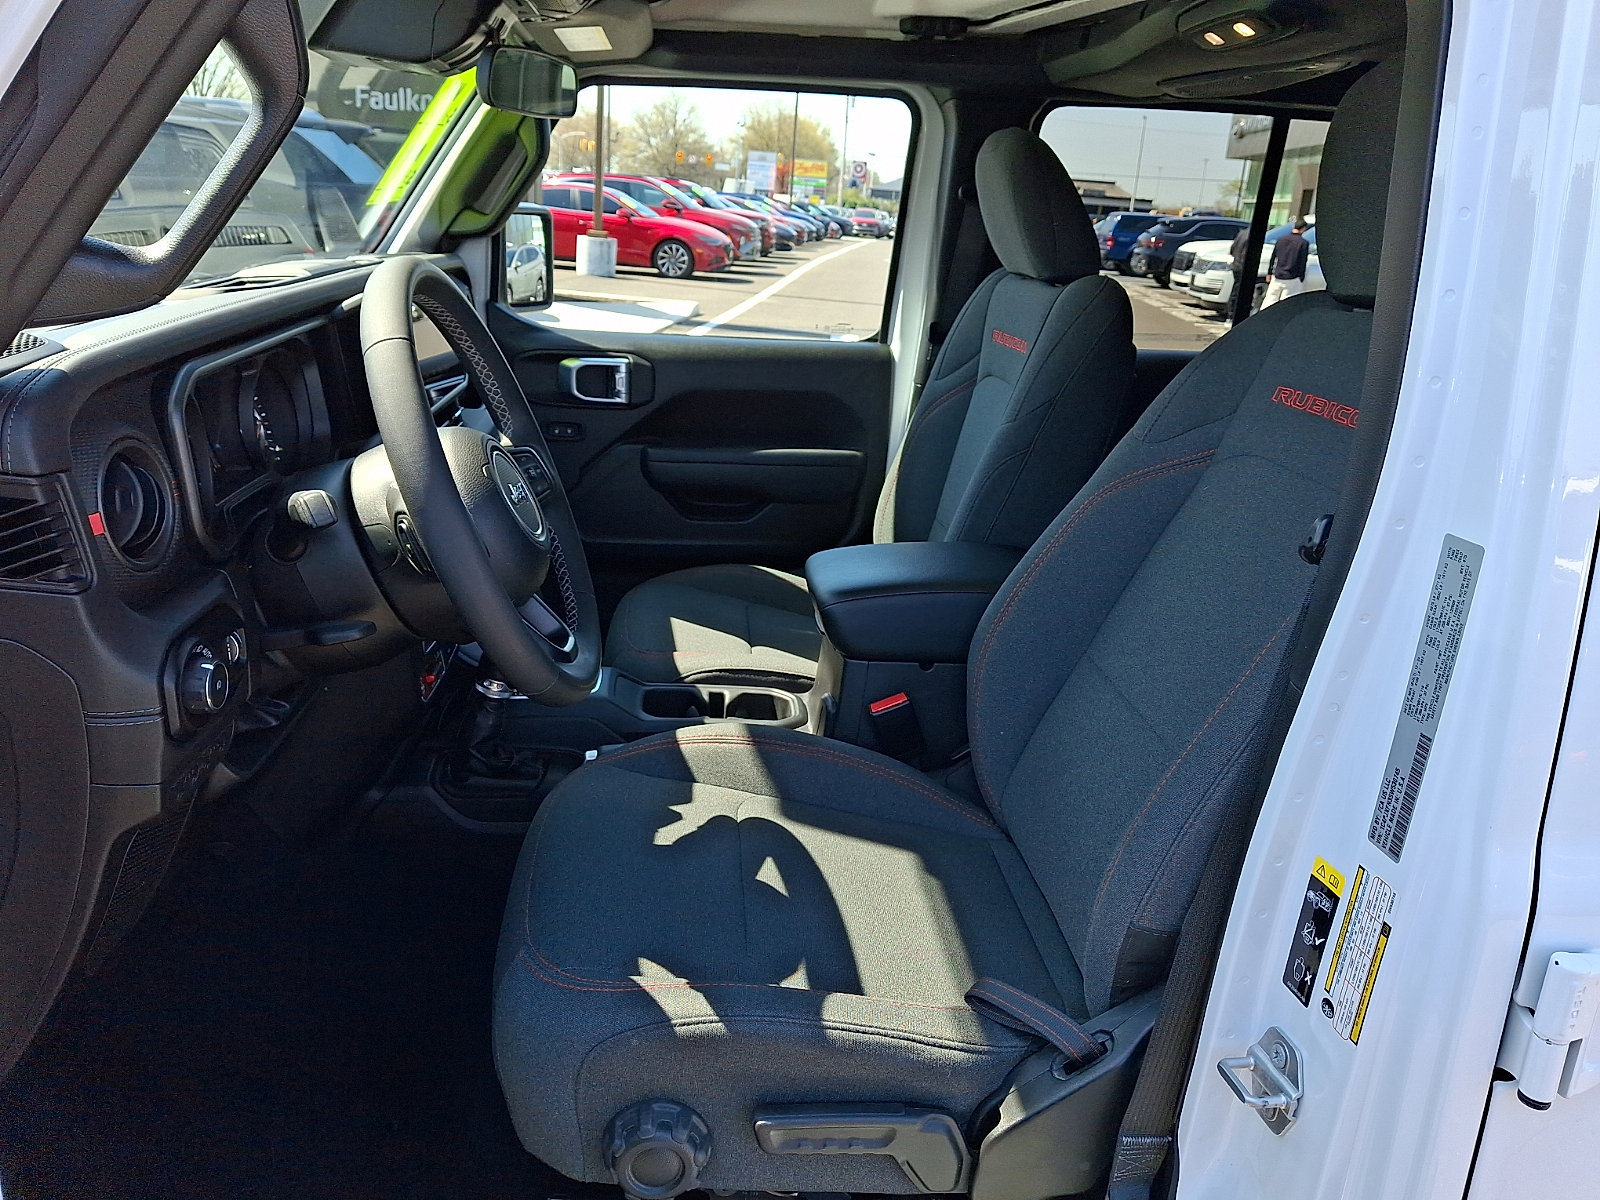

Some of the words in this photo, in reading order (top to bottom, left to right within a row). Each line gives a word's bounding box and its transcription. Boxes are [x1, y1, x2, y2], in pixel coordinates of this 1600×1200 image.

[355, 85, 433, 112] Faulkn
[1272, 386, 1360, 428] RUBICO
[1383, 777, 1391, 790] LLC
[1381, 790, 1387, 800] US
[1377, 800, 1385, 813] FCA
[1370, 826, 1378, 840] MFD
[1381, 824, 1392, 849] VEHICLE
[1389, 806, 1398, 823] MADE
[1376, 831, 1384, 845] VIN:
